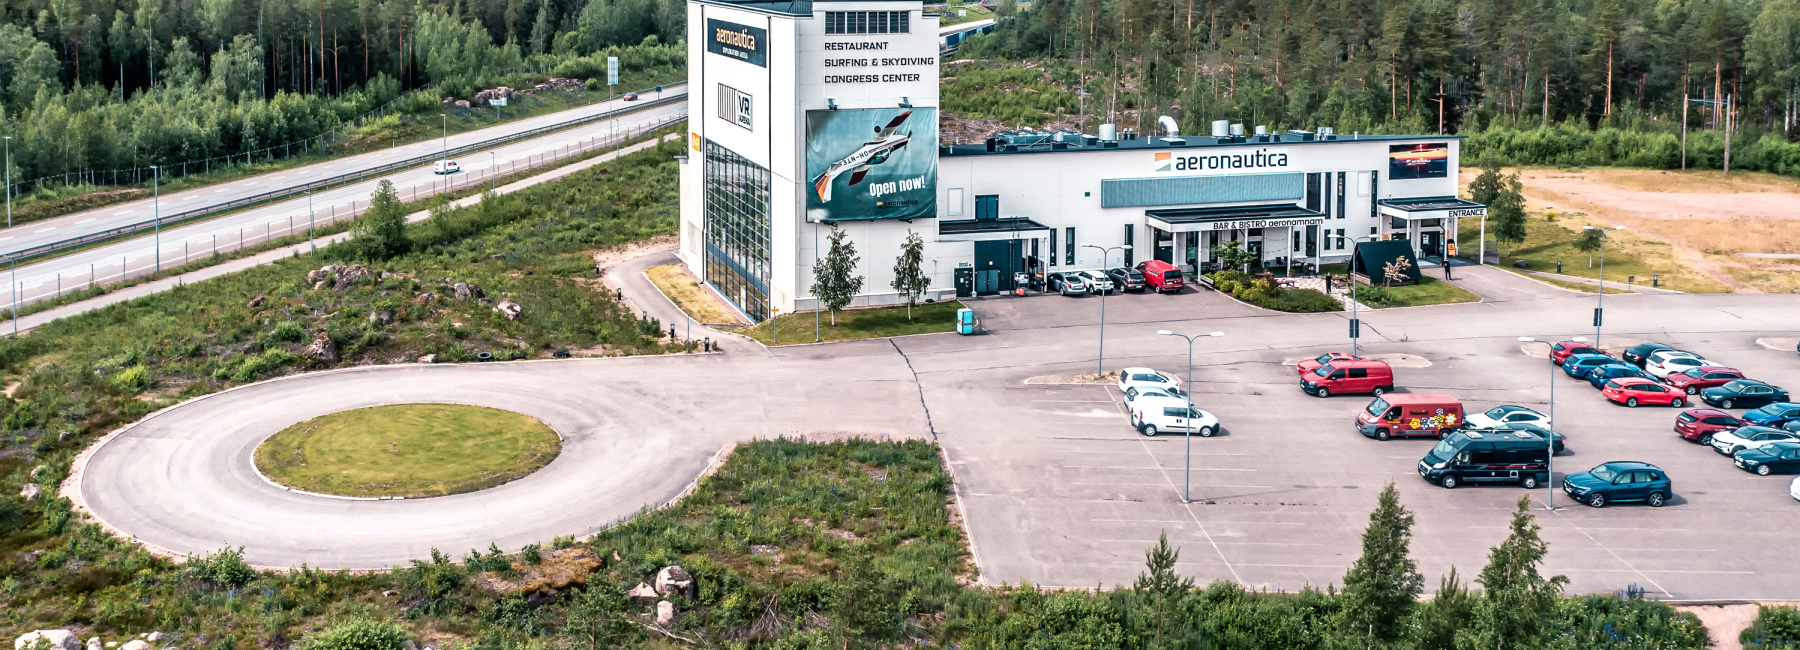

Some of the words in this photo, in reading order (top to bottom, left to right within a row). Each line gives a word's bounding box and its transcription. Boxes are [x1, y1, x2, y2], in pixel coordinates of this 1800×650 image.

[716, 28, 755, 51] aeronautica
[824, 41, 889, 51] RESTAURANT
[824, 58, 868, 67] SURFING
[871, 58, 879, 67] &
[881, 57, 934, 66] SKYDIVING
[824, 74, 879, 84] CONGRESS
[882, 73, 920, 83] CENTER
[738, 95, 750, 116] VR
[1175, 148, 1288, 171] aeronautica
[869, 181, 897, 198] Open
[899, 175, 926, 192] now!
[1448, 208, 1485, 218] ENTRANCE
[1213, 222, 1229, 230] BAR
[1230, 221, 1237, 229] &
[1240, 220, 1267, 229] BISTRO
[1268, 218, 1324, 227] aeronamnam
